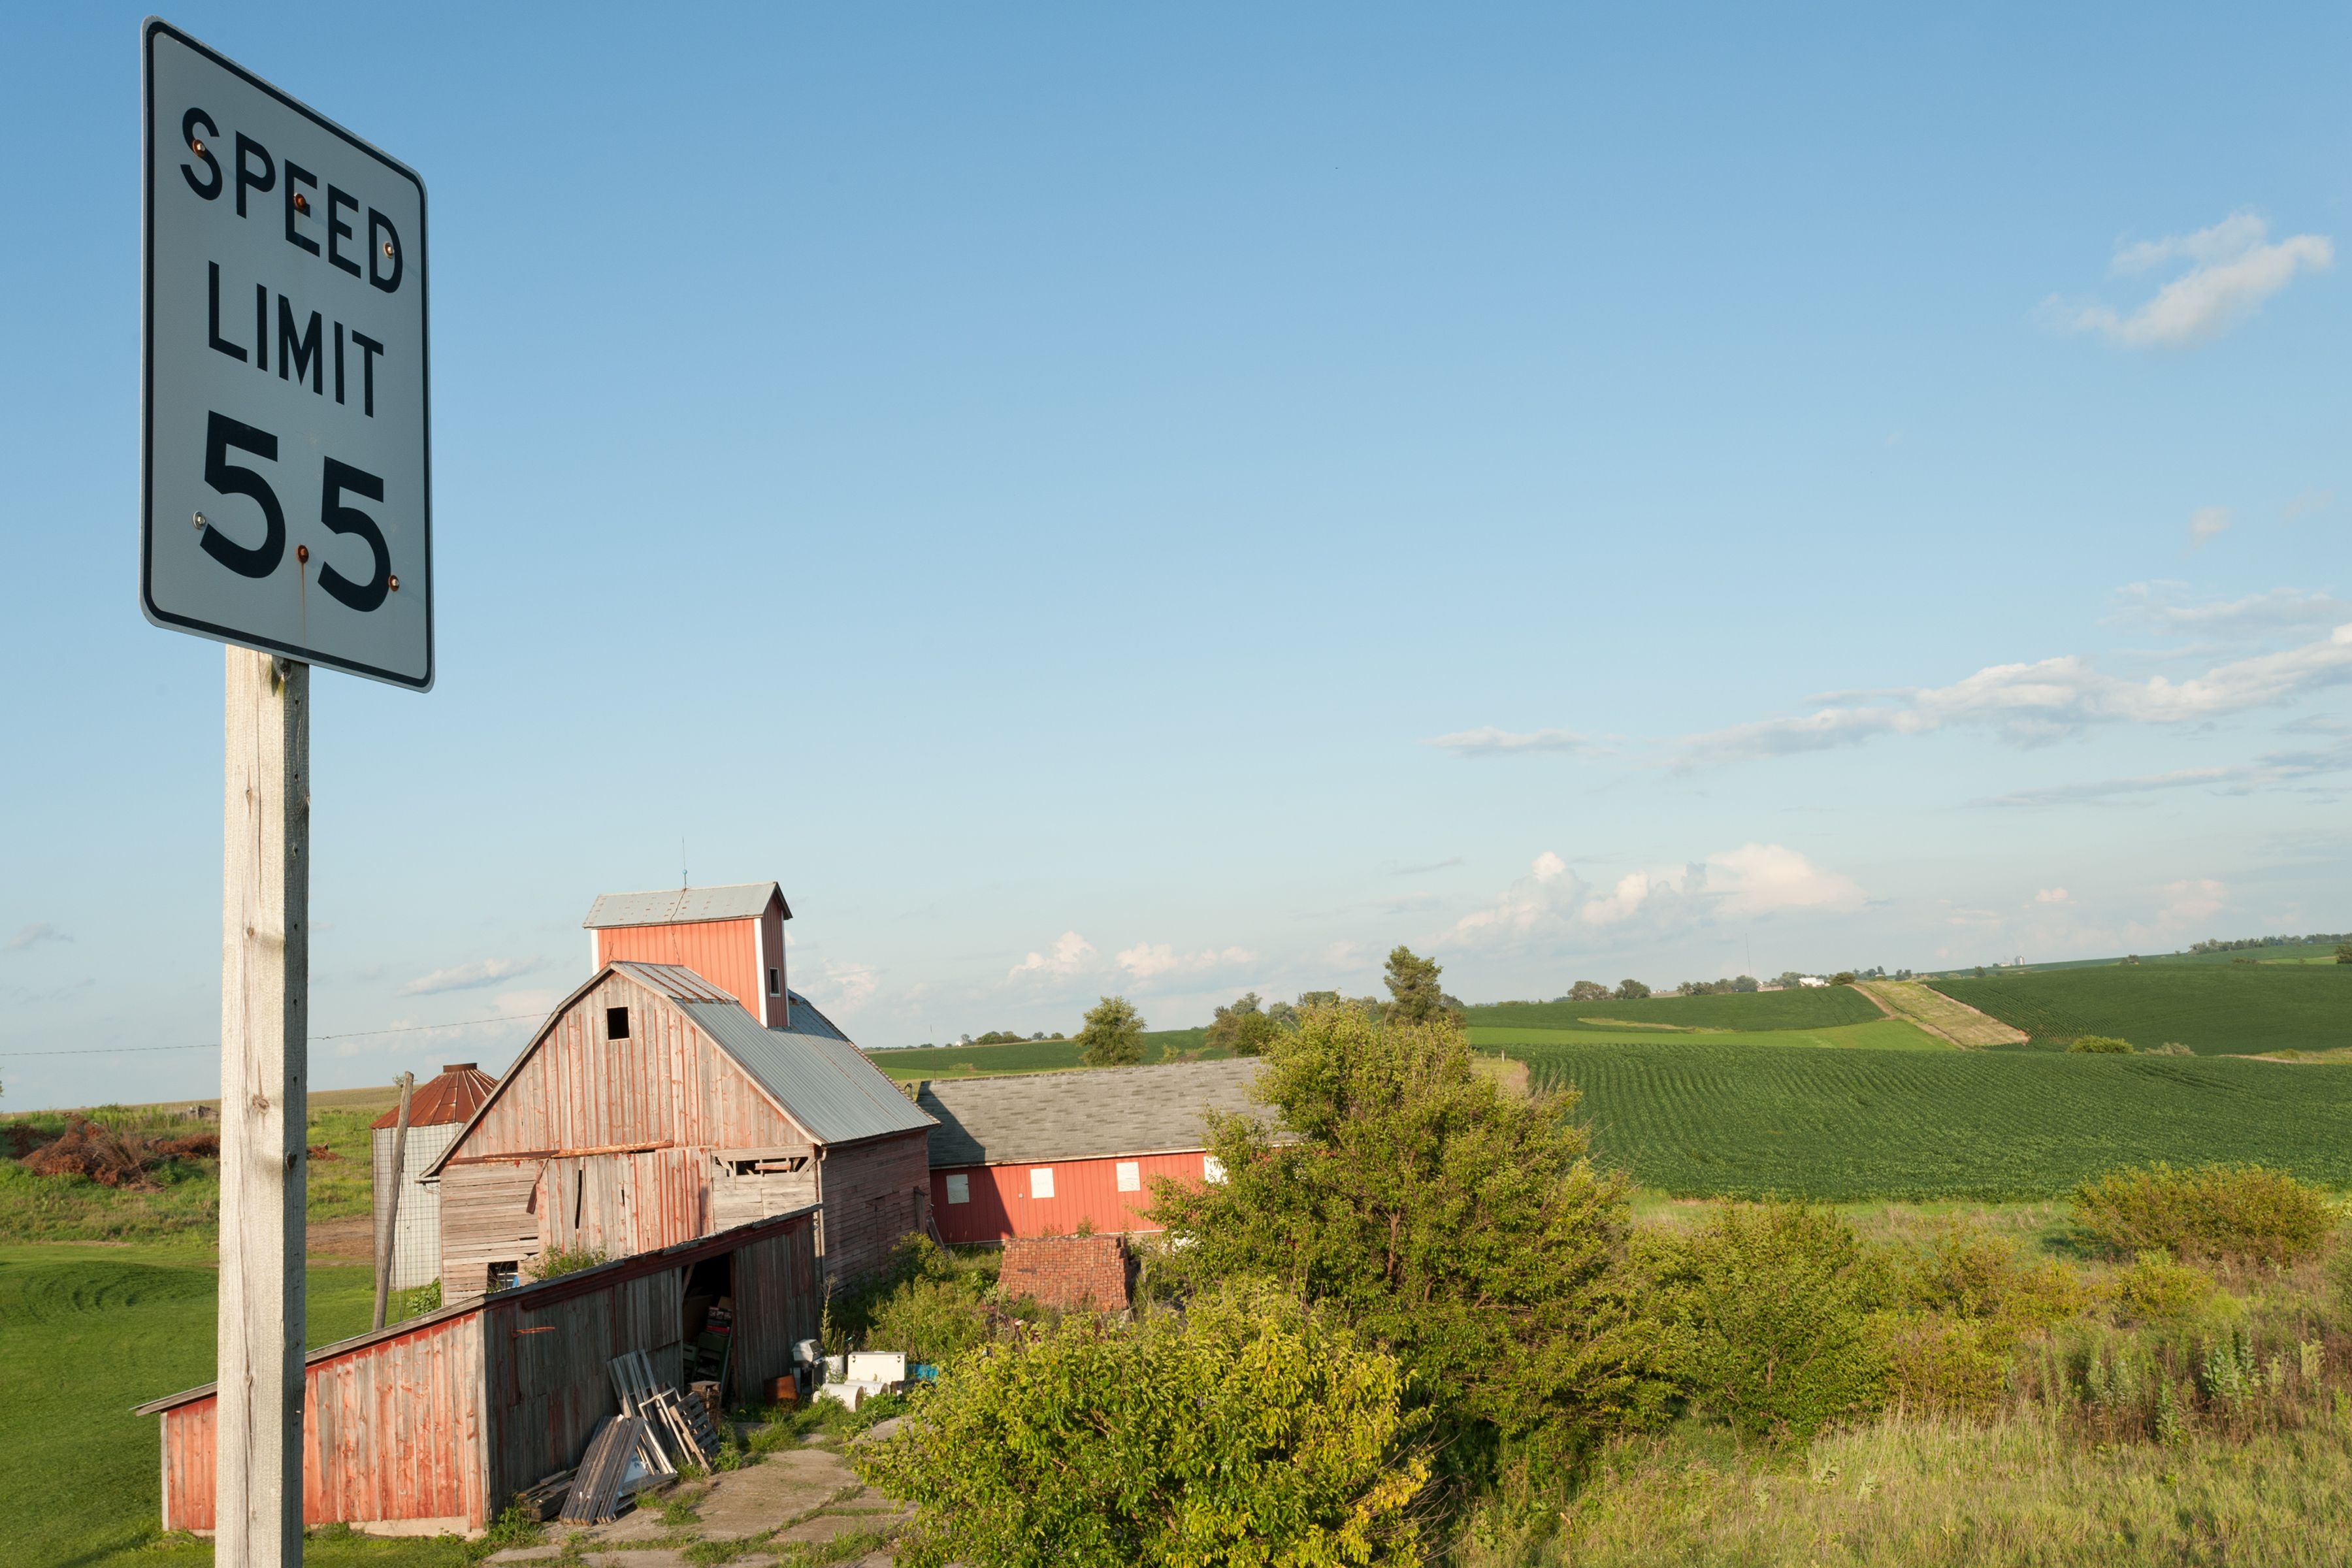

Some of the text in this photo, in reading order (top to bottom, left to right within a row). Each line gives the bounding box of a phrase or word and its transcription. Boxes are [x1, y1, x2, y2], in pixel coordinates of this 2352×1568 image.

[180, 107, 403, 293] SPEED
[208, 260, 384, 418] LIMIT
[199, 410, 391, 613] 55
